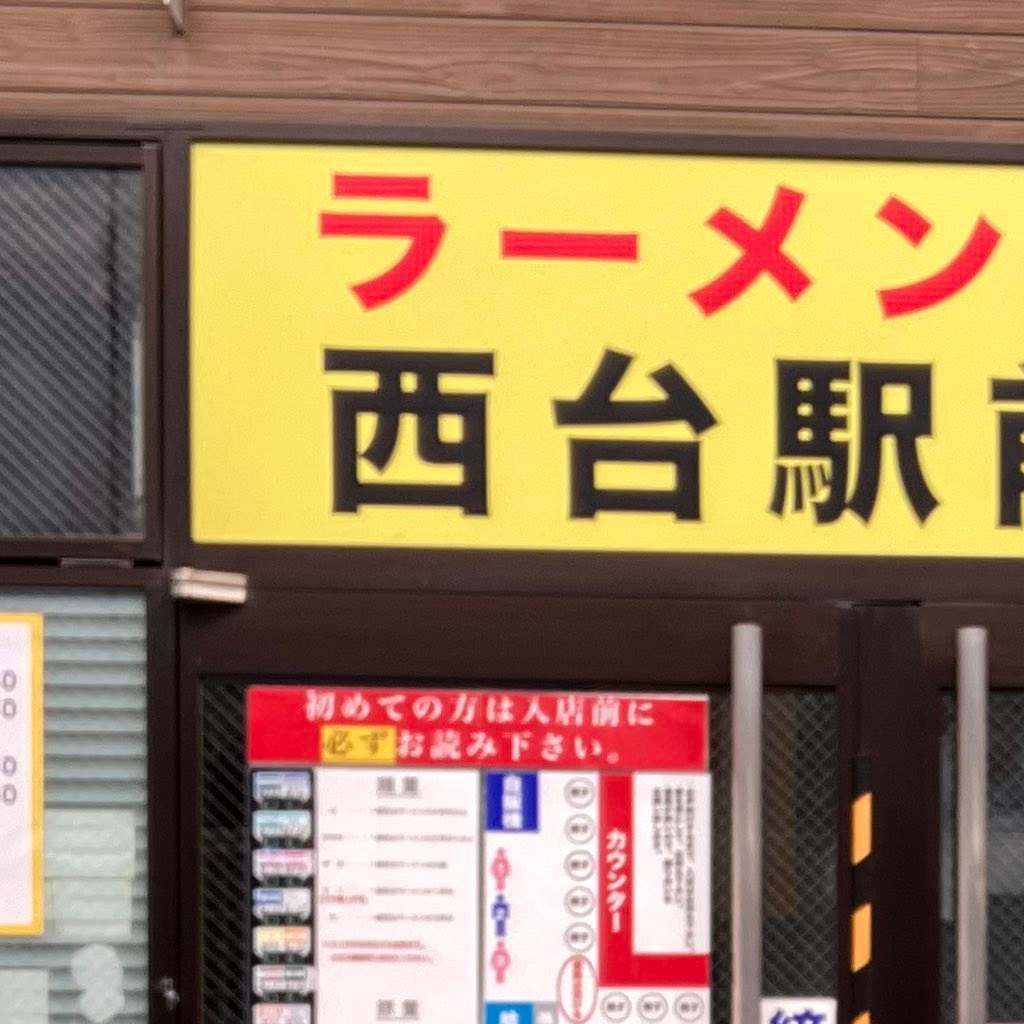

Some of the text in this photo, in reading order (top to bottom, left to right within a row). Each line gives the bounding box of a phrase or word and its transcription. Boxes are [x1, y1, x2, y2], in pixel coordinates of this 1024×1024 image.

[304, 688, 657, 728] 初めての方は入店前に
[605, 828, 628, 933] カウンター
